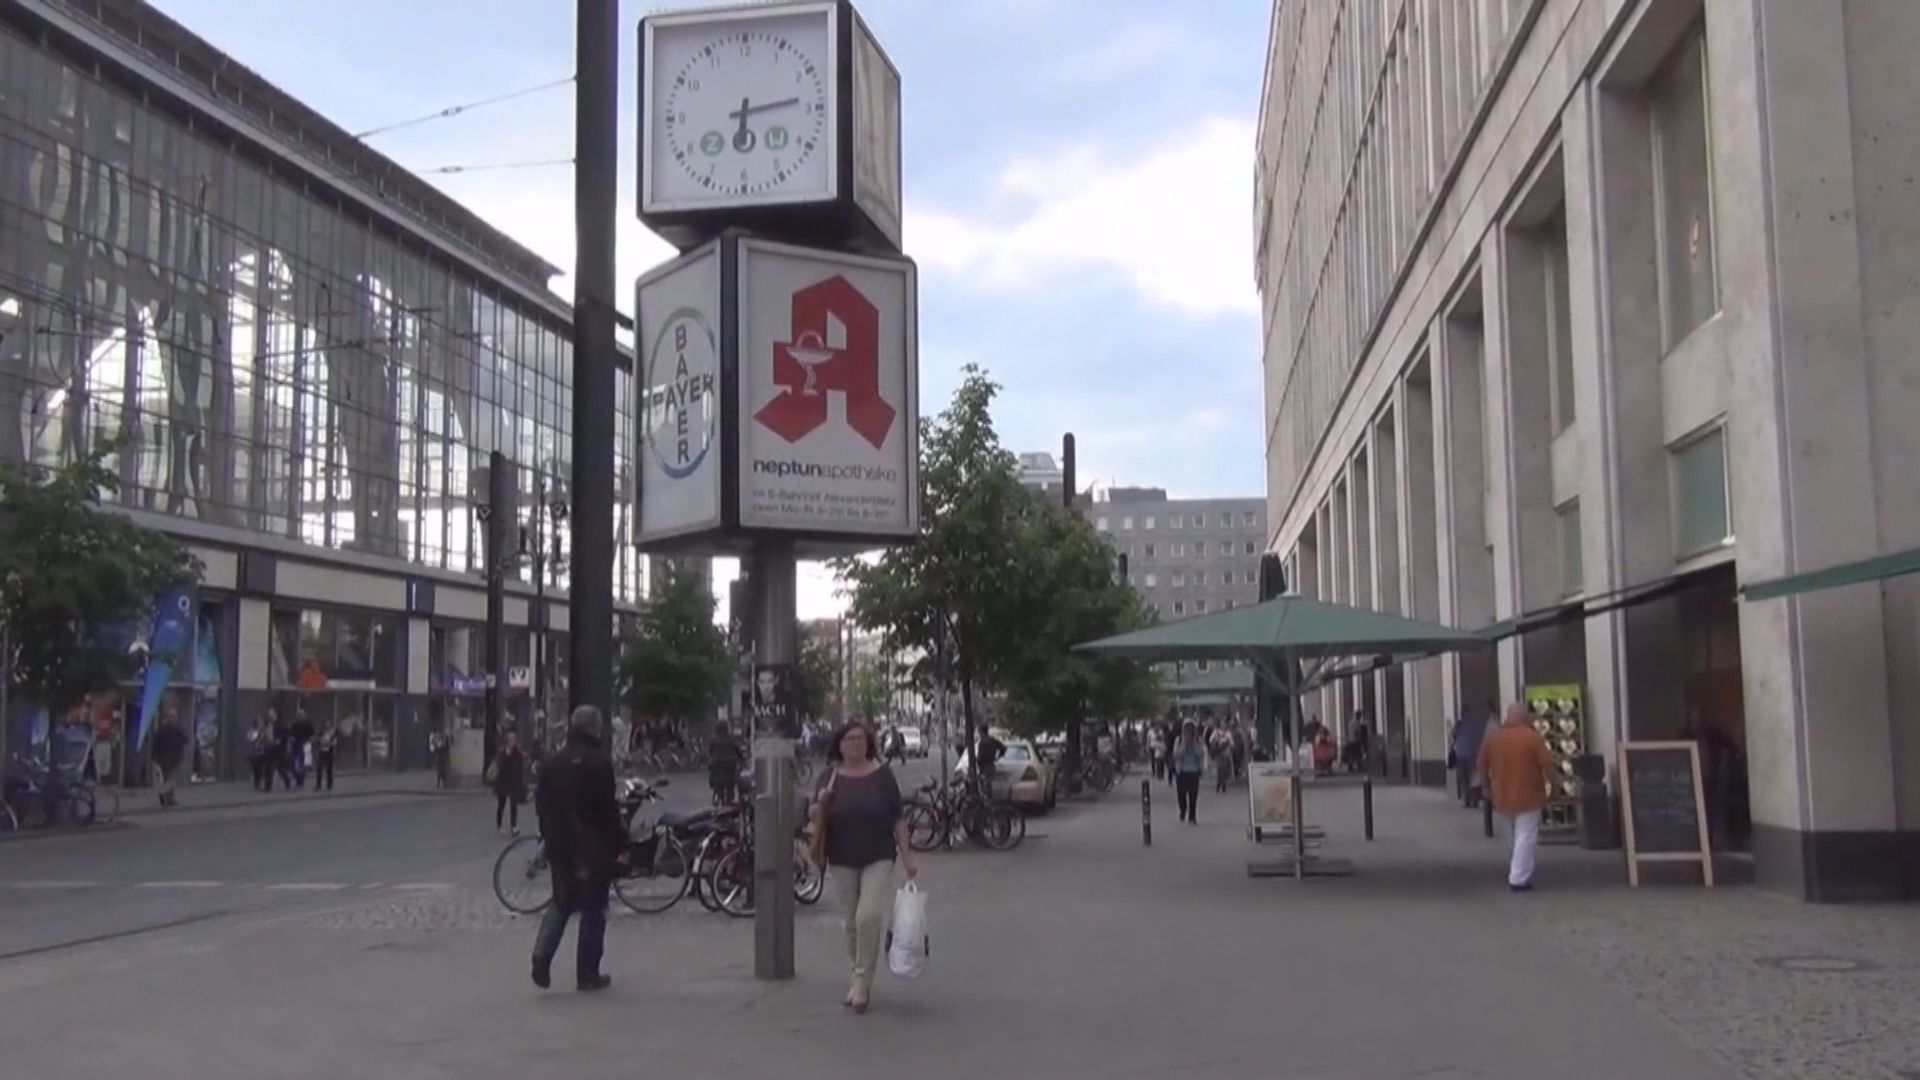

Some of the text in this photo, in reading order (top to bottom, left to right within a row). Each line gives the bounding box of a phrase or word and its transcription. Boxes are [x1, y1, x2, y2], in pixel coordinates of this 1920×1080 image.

[740, 46, 751, 57] 12
[711, 57, 721, 70] 11
[688, 80, 700, 92] 10
[674, 322, 690, 465] BAYER
[753, 459, 896, 481] neptunapotheke
